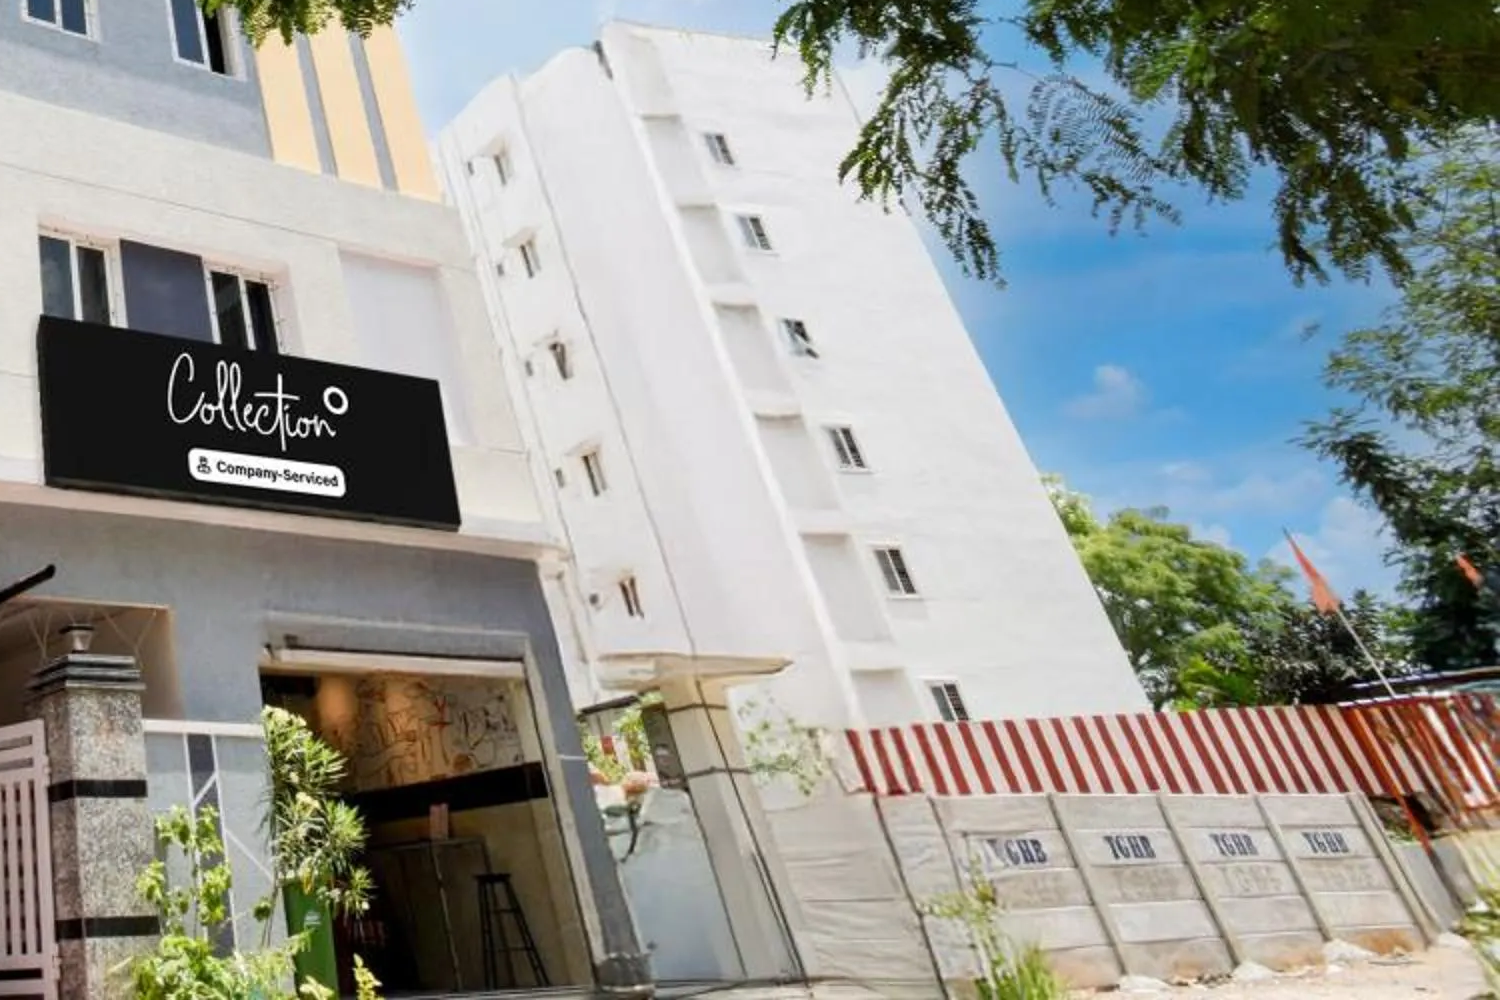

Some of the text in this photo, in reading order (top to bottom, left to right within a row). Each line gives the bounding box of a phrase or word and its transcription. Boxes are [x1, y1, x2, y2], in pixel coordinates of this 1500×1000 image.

[167, 353, 337, 451] Collection
[216, 460, 340, 487] Company-Serviced
[1103, 835, 1156, 859] TGHB
